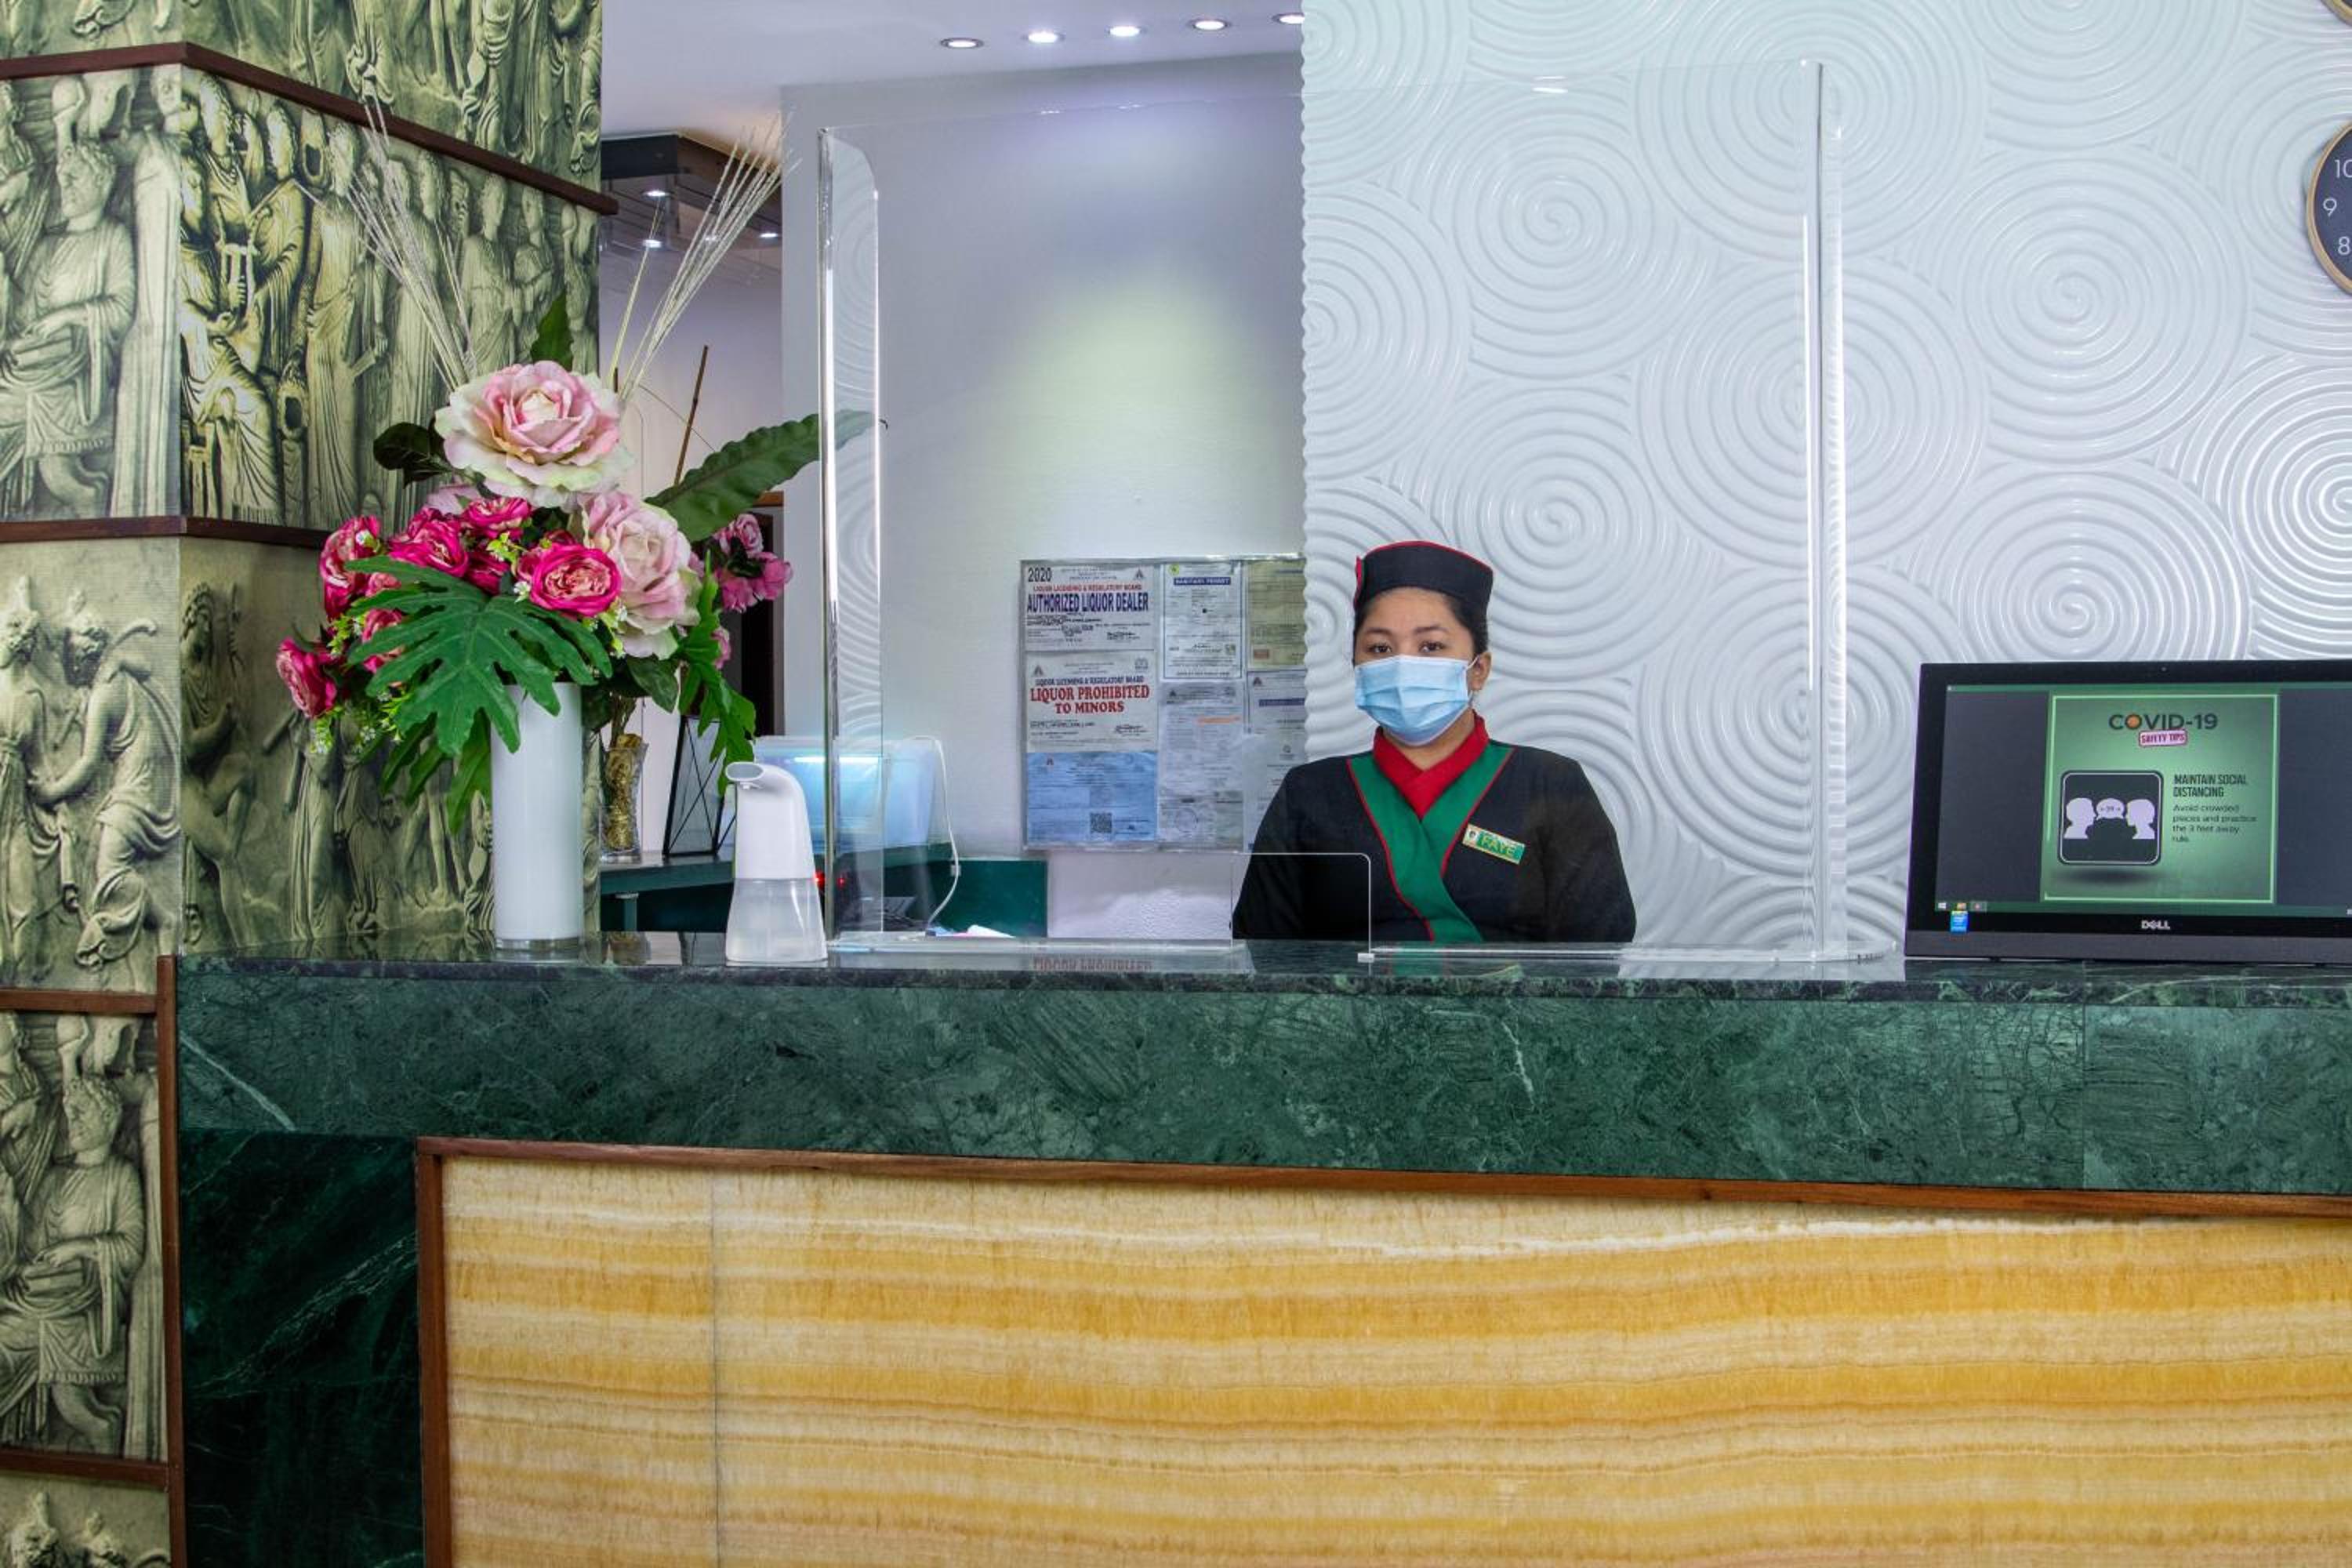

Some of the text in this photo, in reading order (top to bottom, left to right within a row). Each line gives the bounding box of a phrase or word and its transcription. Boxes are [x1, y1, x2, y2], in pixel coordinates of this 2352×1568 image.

[2323, 198, 2337, 217] 9
[2338, 236, 2350, 255] 8
[1028, 567, 1052, 583] 2020
[1027, 592, 1149, 614] AUTHORIZED LIQUOR DEALER
[1031, 687, 1074, 704] LIQUOR
[1078, 684, 1150, 700] PROHIBITED
[1054, 701, 1124, 714] TO MINORS
[2109, 713, 2218, 730] COVID-19
[2141, 733, 2185, 744] SAFETY TIPS
[2174, 774, 2247, 785] MAINTAIN SOCIAL
[2172, 786, 2224, 797] DISTANCING
[1481, 835, 1517, 856] FAYE
[2141, 920, 2171, 931] DELL
